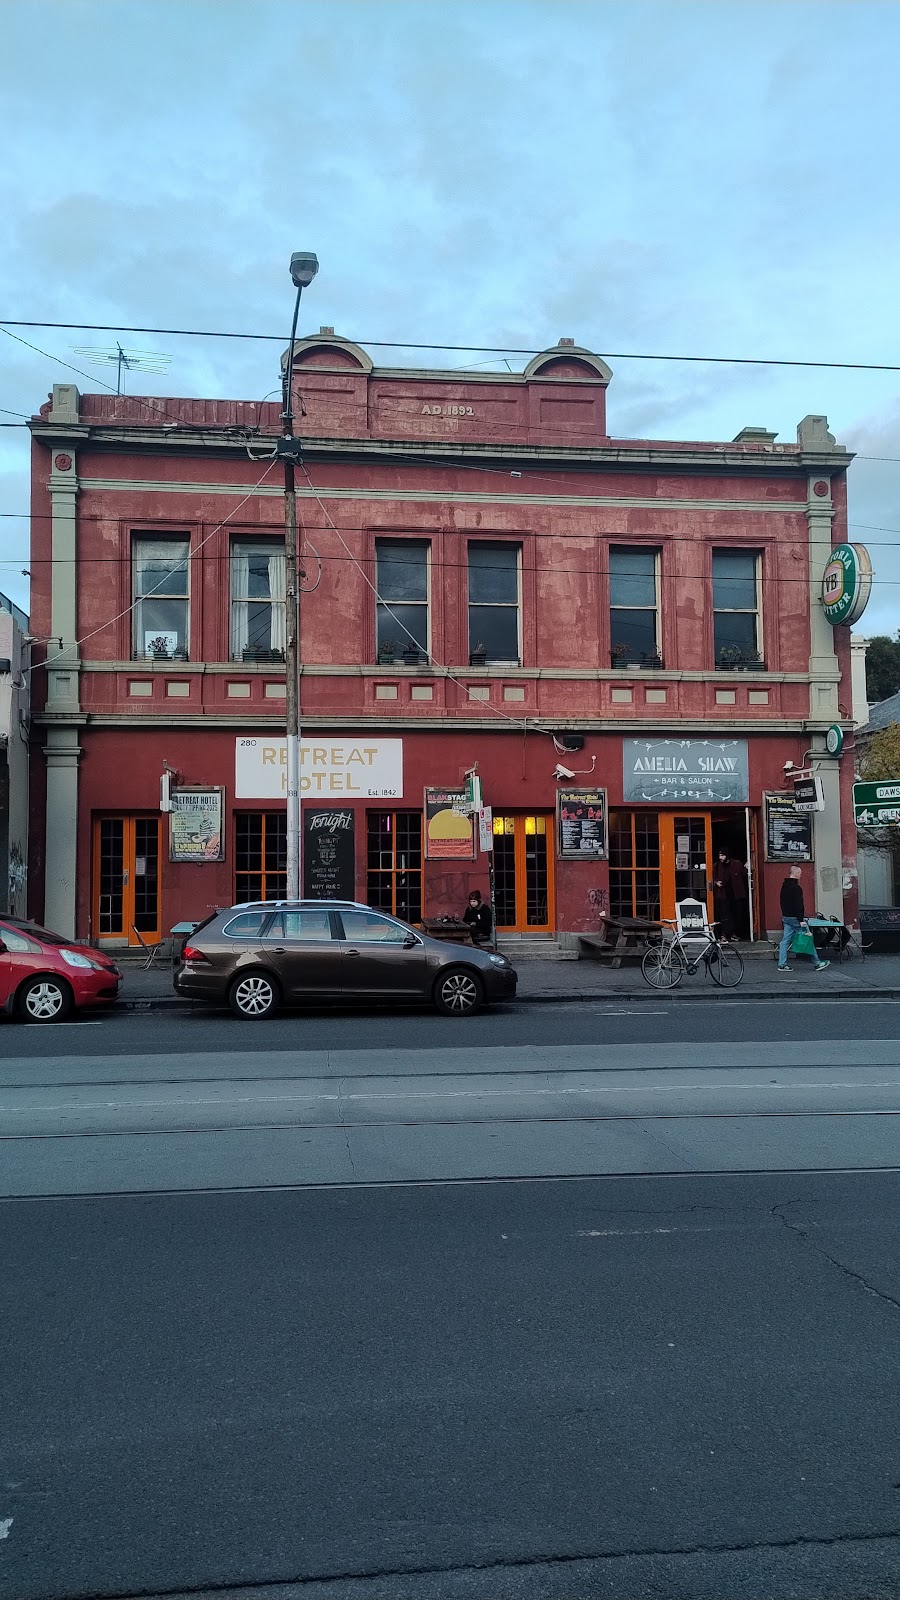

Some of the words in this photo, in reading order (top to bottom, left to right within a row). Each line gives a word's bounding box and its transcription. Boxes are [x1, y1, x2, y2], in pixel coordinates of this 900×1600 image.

[825, 573, 837, 592] VB
[262, 747, 378, 766] RETREAT
[633, 756, 688, 771] AMELIA
[697, 757, 738, 772] SHAW
[688, 777, 713, 785] SALON
[879, 788, 900, 797] DAWS
[200, 796, 218, 805] HOTEL
[797, 803, 814, 811] LOUNGE
[310, 812, 352, 833] Tonight
[681, 917, 704, 928] OPEN
